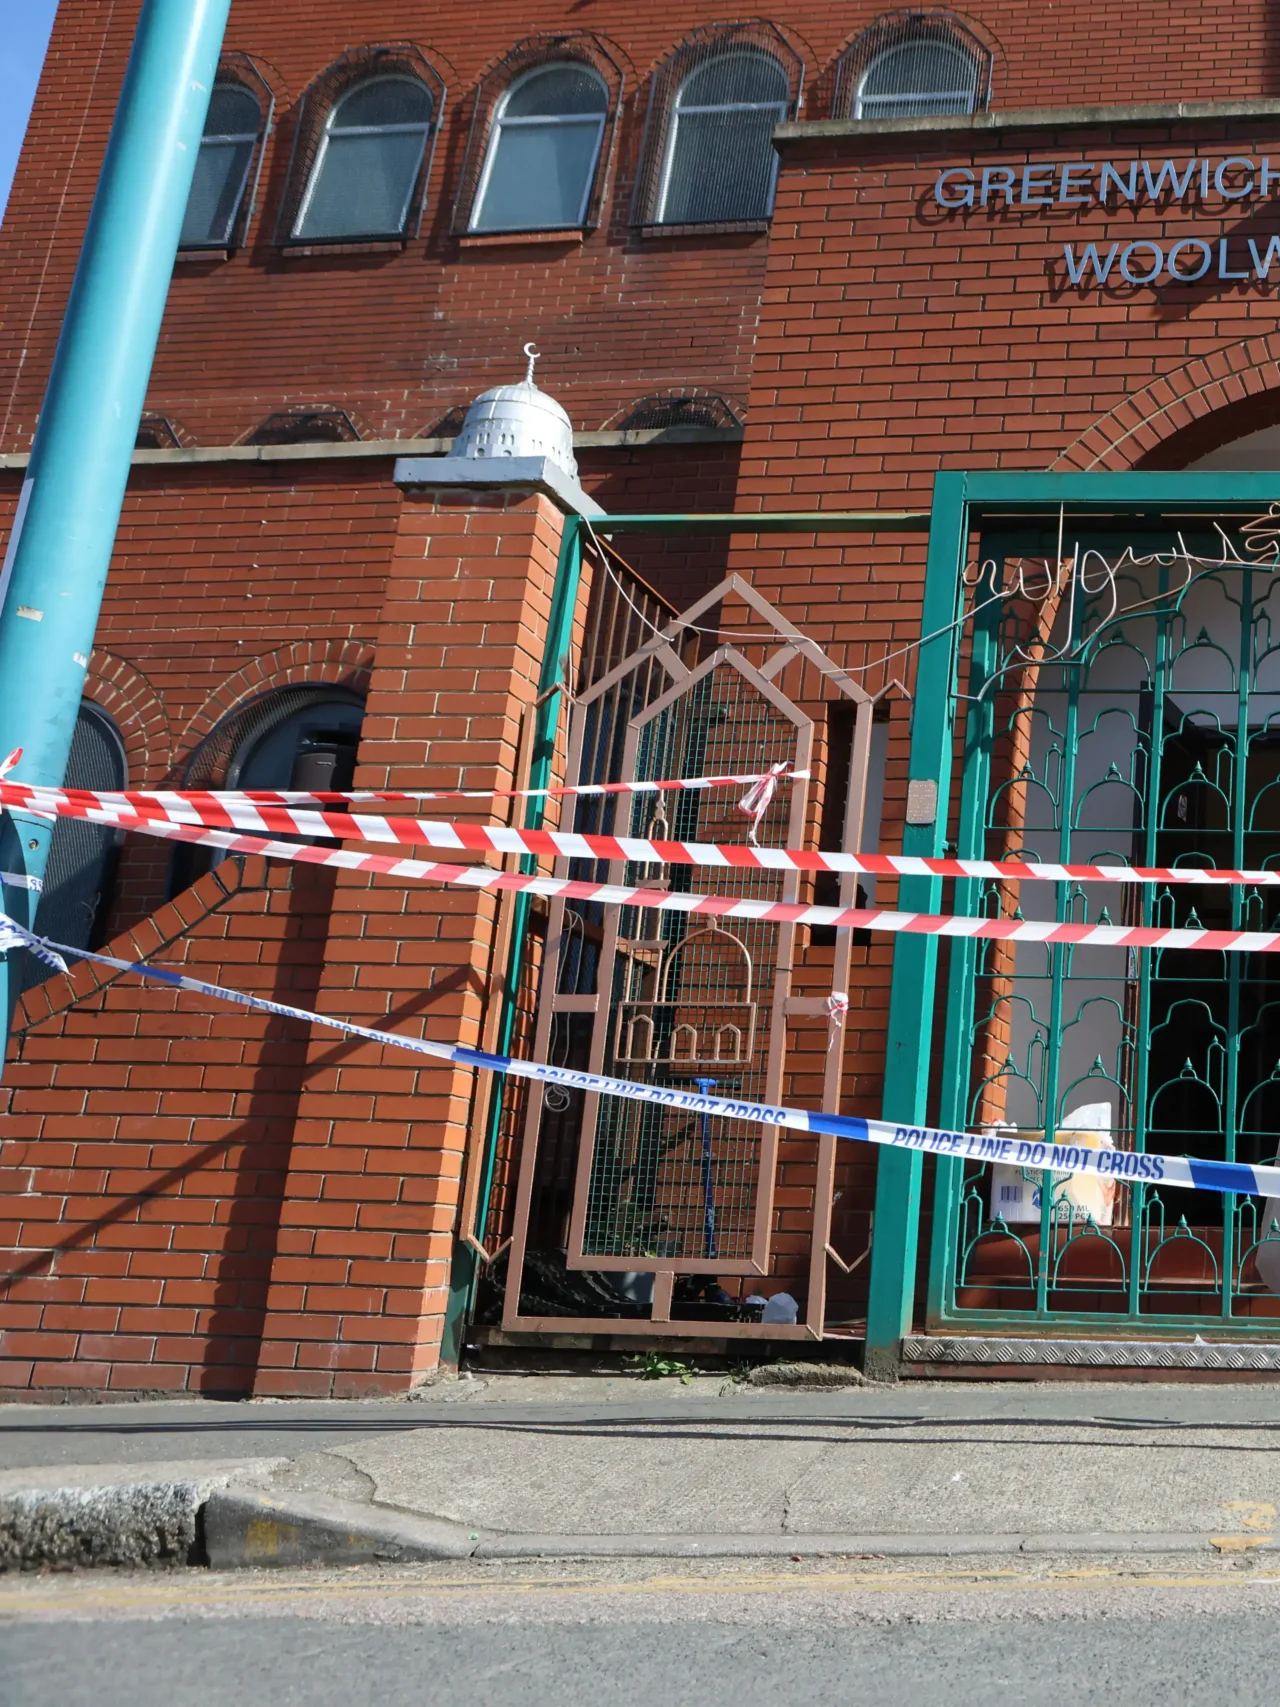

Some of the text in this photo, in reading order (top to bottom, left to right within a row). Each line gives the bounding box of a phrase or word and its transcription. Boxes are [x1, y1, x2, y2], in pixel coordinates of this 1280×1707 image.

[892, 1127, 1165, 1180] POLICE LINE DO NOT CROSS
